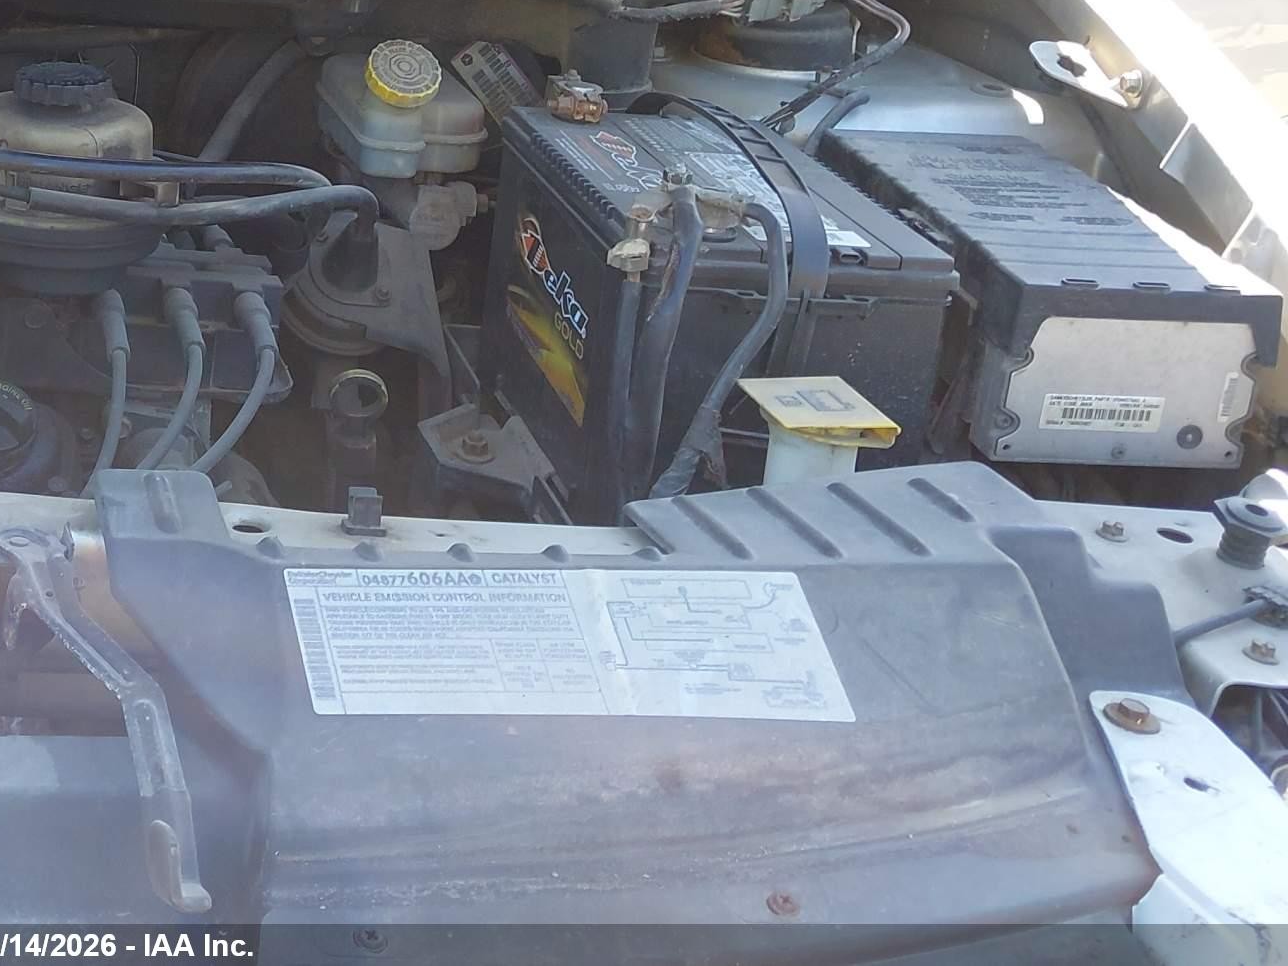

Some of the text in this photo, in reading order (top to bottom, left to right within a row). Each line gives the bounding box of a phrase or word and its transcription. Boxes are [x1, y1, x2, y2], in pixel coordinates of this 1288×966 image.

[554, 311, 584, 360] GOLD
[491, 572, 558, 584] CATALYST
[322, 592, 567, 604] VEHICLE EMISSION CONTROL INFORMATION
